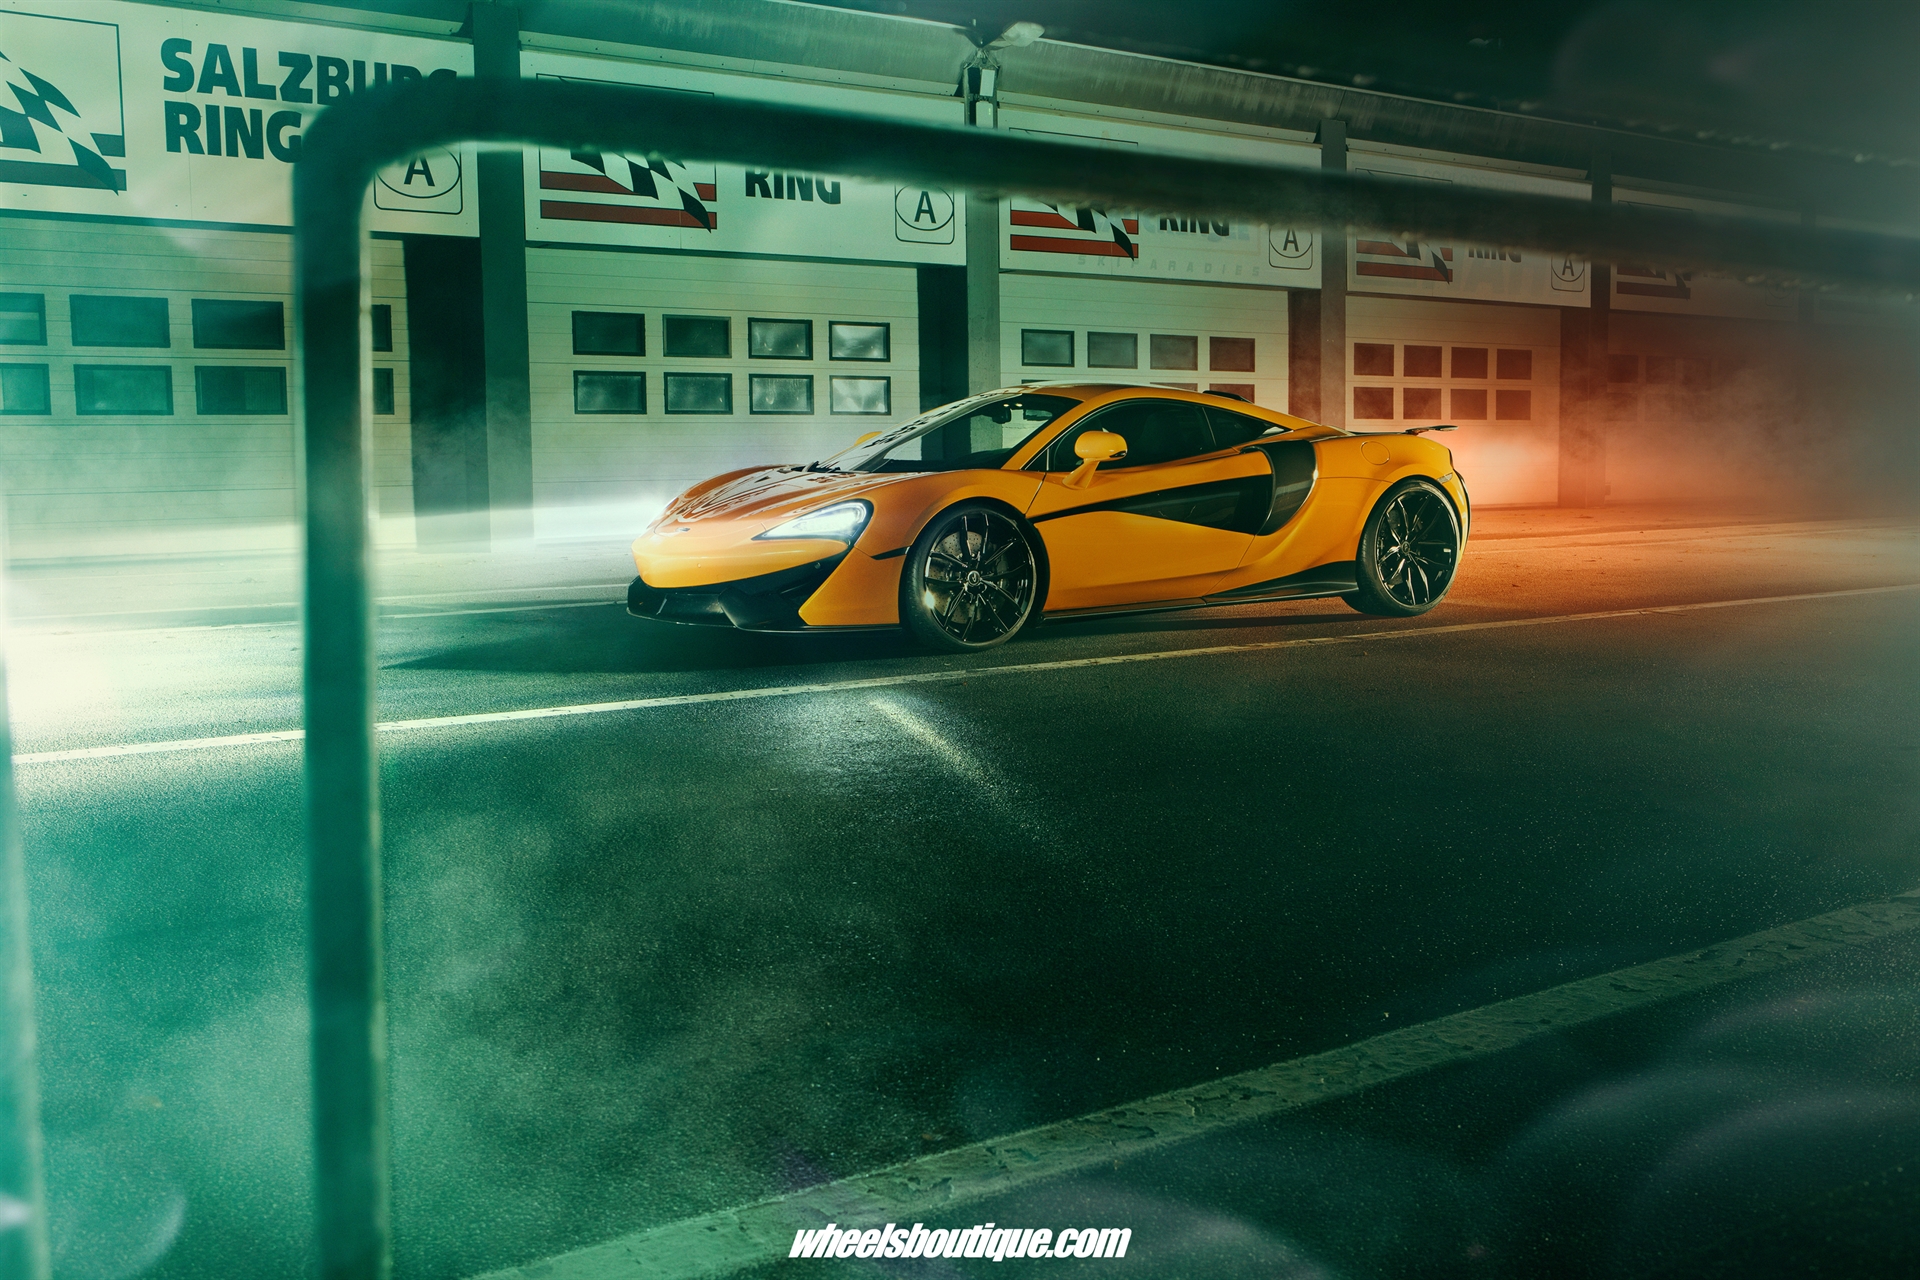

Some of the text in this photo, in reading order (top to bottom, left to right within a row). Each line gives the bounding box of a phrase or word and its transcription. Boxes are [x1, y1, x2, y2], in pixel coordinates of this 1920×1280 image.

[160, 37, 457, 108] SALZB
[164, 100, 303, 163] RING
[403, 149, 435, 187] A
[914, 190, 936, 224] A
[1282, 226, 1300, 252] A
